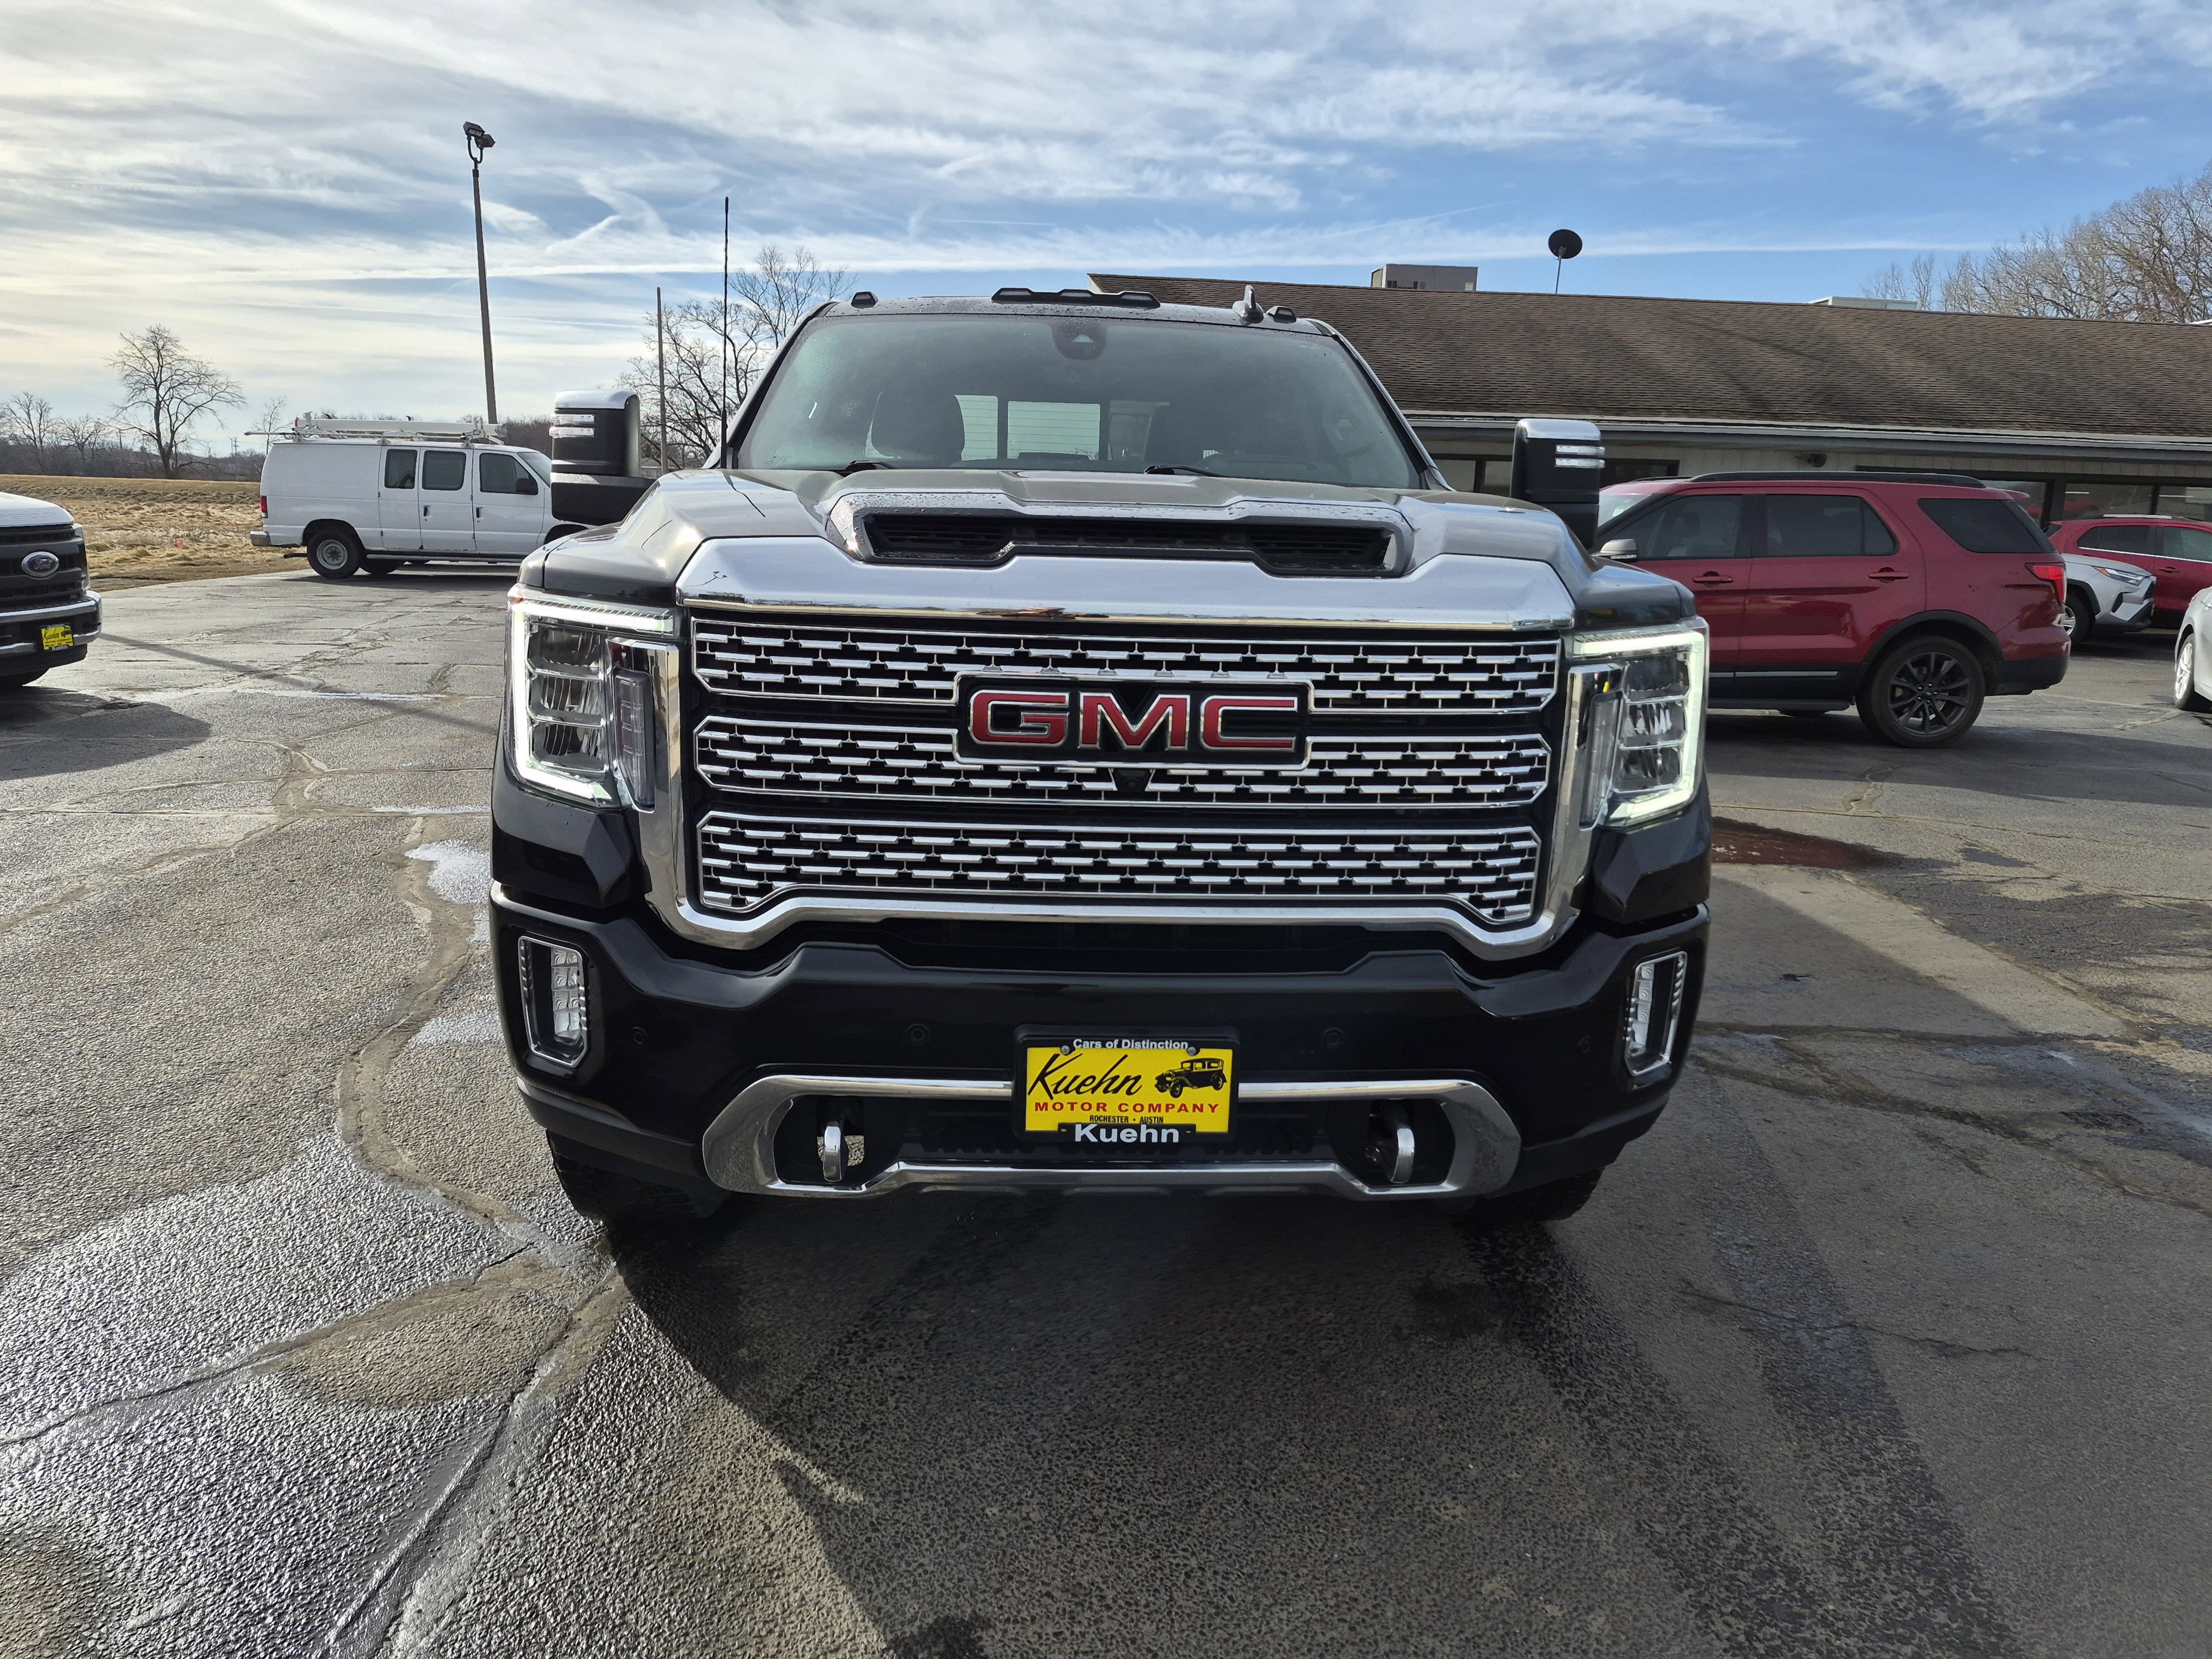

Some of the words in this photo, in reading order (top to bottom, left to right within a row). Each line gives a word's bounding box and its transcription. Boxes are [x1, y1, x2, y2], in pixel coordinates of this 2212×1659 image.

[43, 628, 59, 641] Kuehn
[969, 689, 1298, 753] GMC
[1073, 1039, 1102, 1048] Cars
[1105, 1039, 1119, 1048] of
[1121, 1039, 1188, 1050] Distinction
[1027, 1053, 1142, 1100] Kuehn
[1035, 1102, 1107, 1112] MOTOR
[1118, 1102, 1219, 1113] COMPANY
[1089, 1115, 1129, 1123] ROCHESTER
[1074, 1123, 1179, 1143] Kuehn
